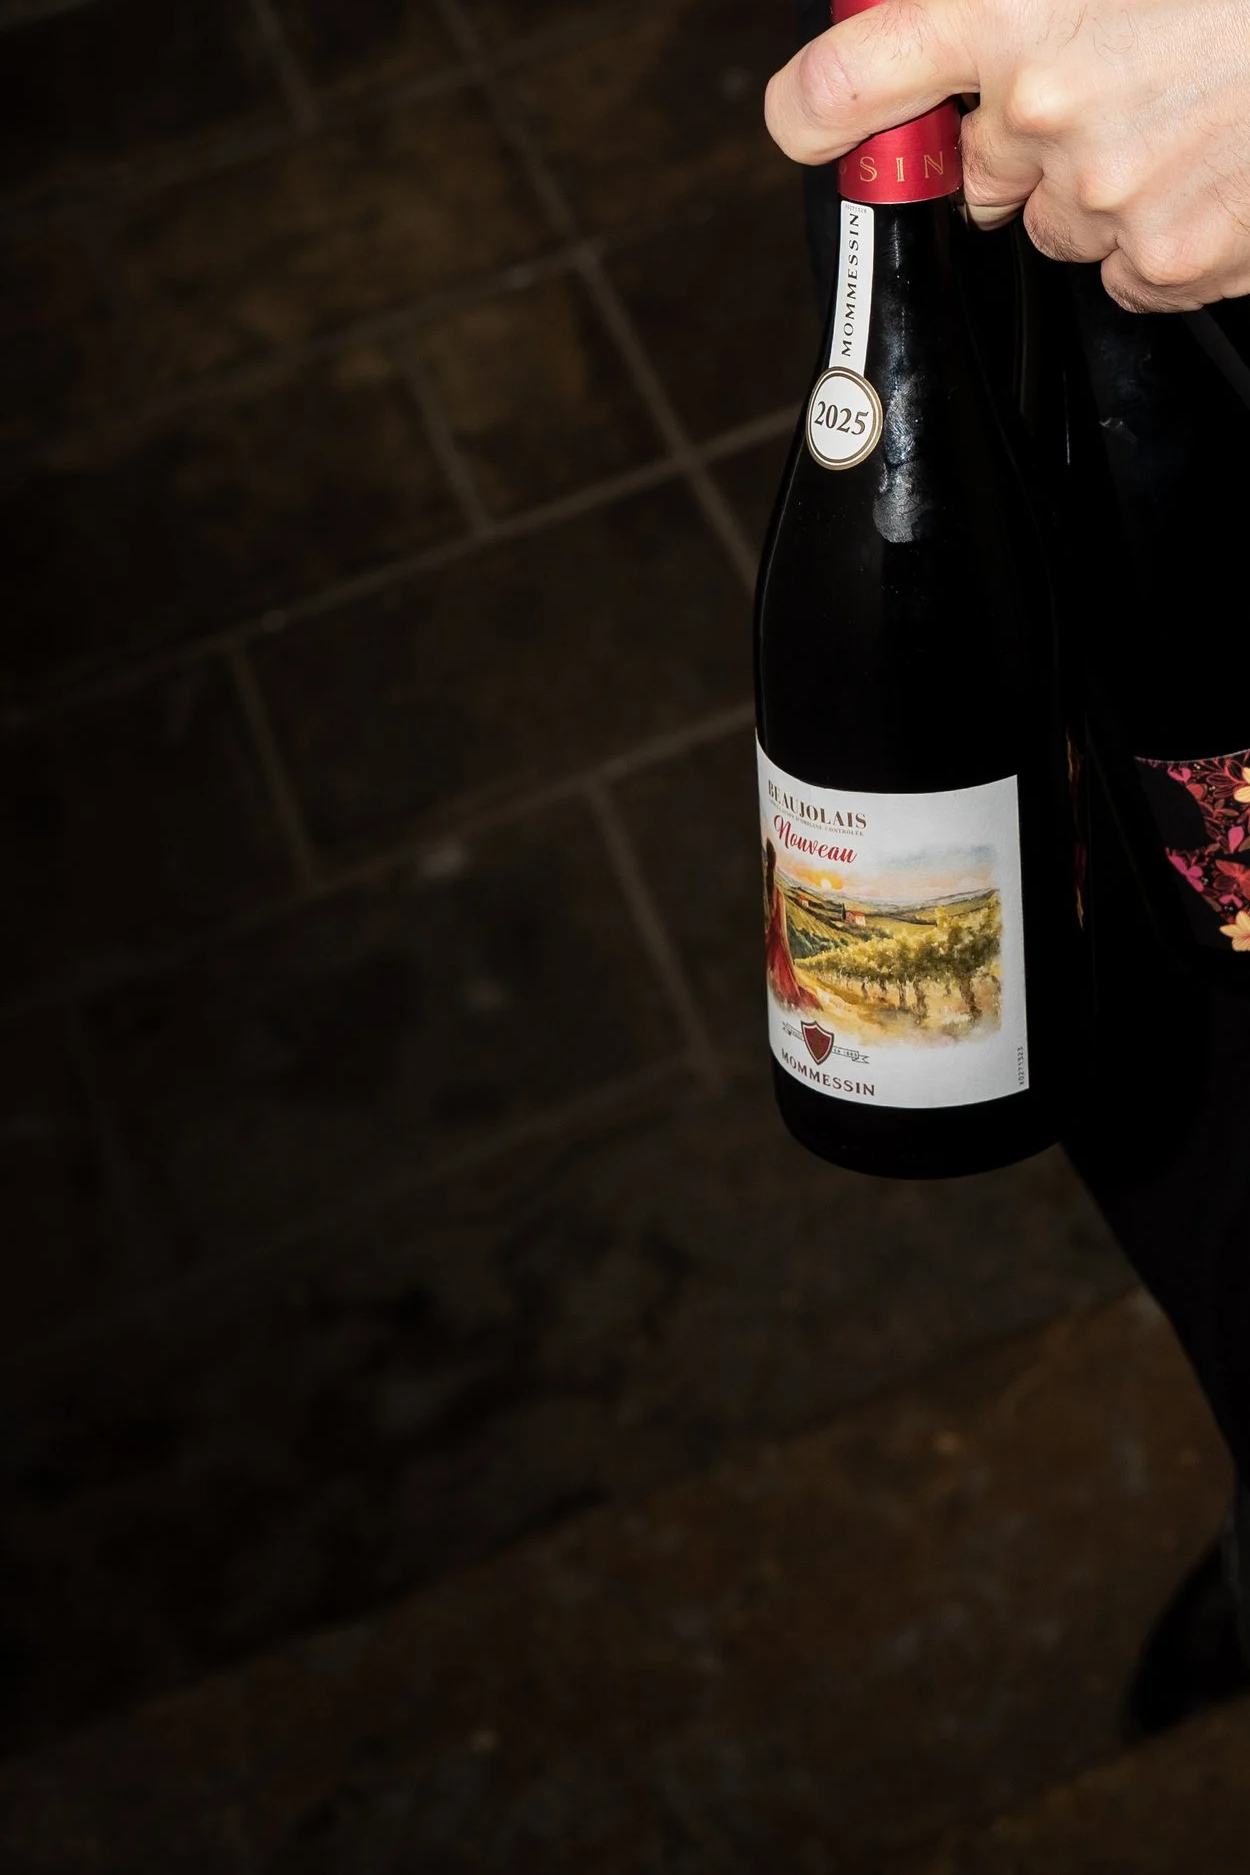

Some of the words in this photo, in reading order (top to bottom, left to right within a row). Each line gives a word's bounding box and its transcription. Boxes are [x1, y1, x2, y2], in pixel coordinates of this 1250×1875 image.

[841, 213, 859, 357] MOMMESSIN
[814, 400, 869, 436] 2025
[768, 779, 867, 829] BEAUJOLAIS
[773, 815, 857, 864] Nouveau
[781, 1047, 875, 1096] MOMMESSIN
